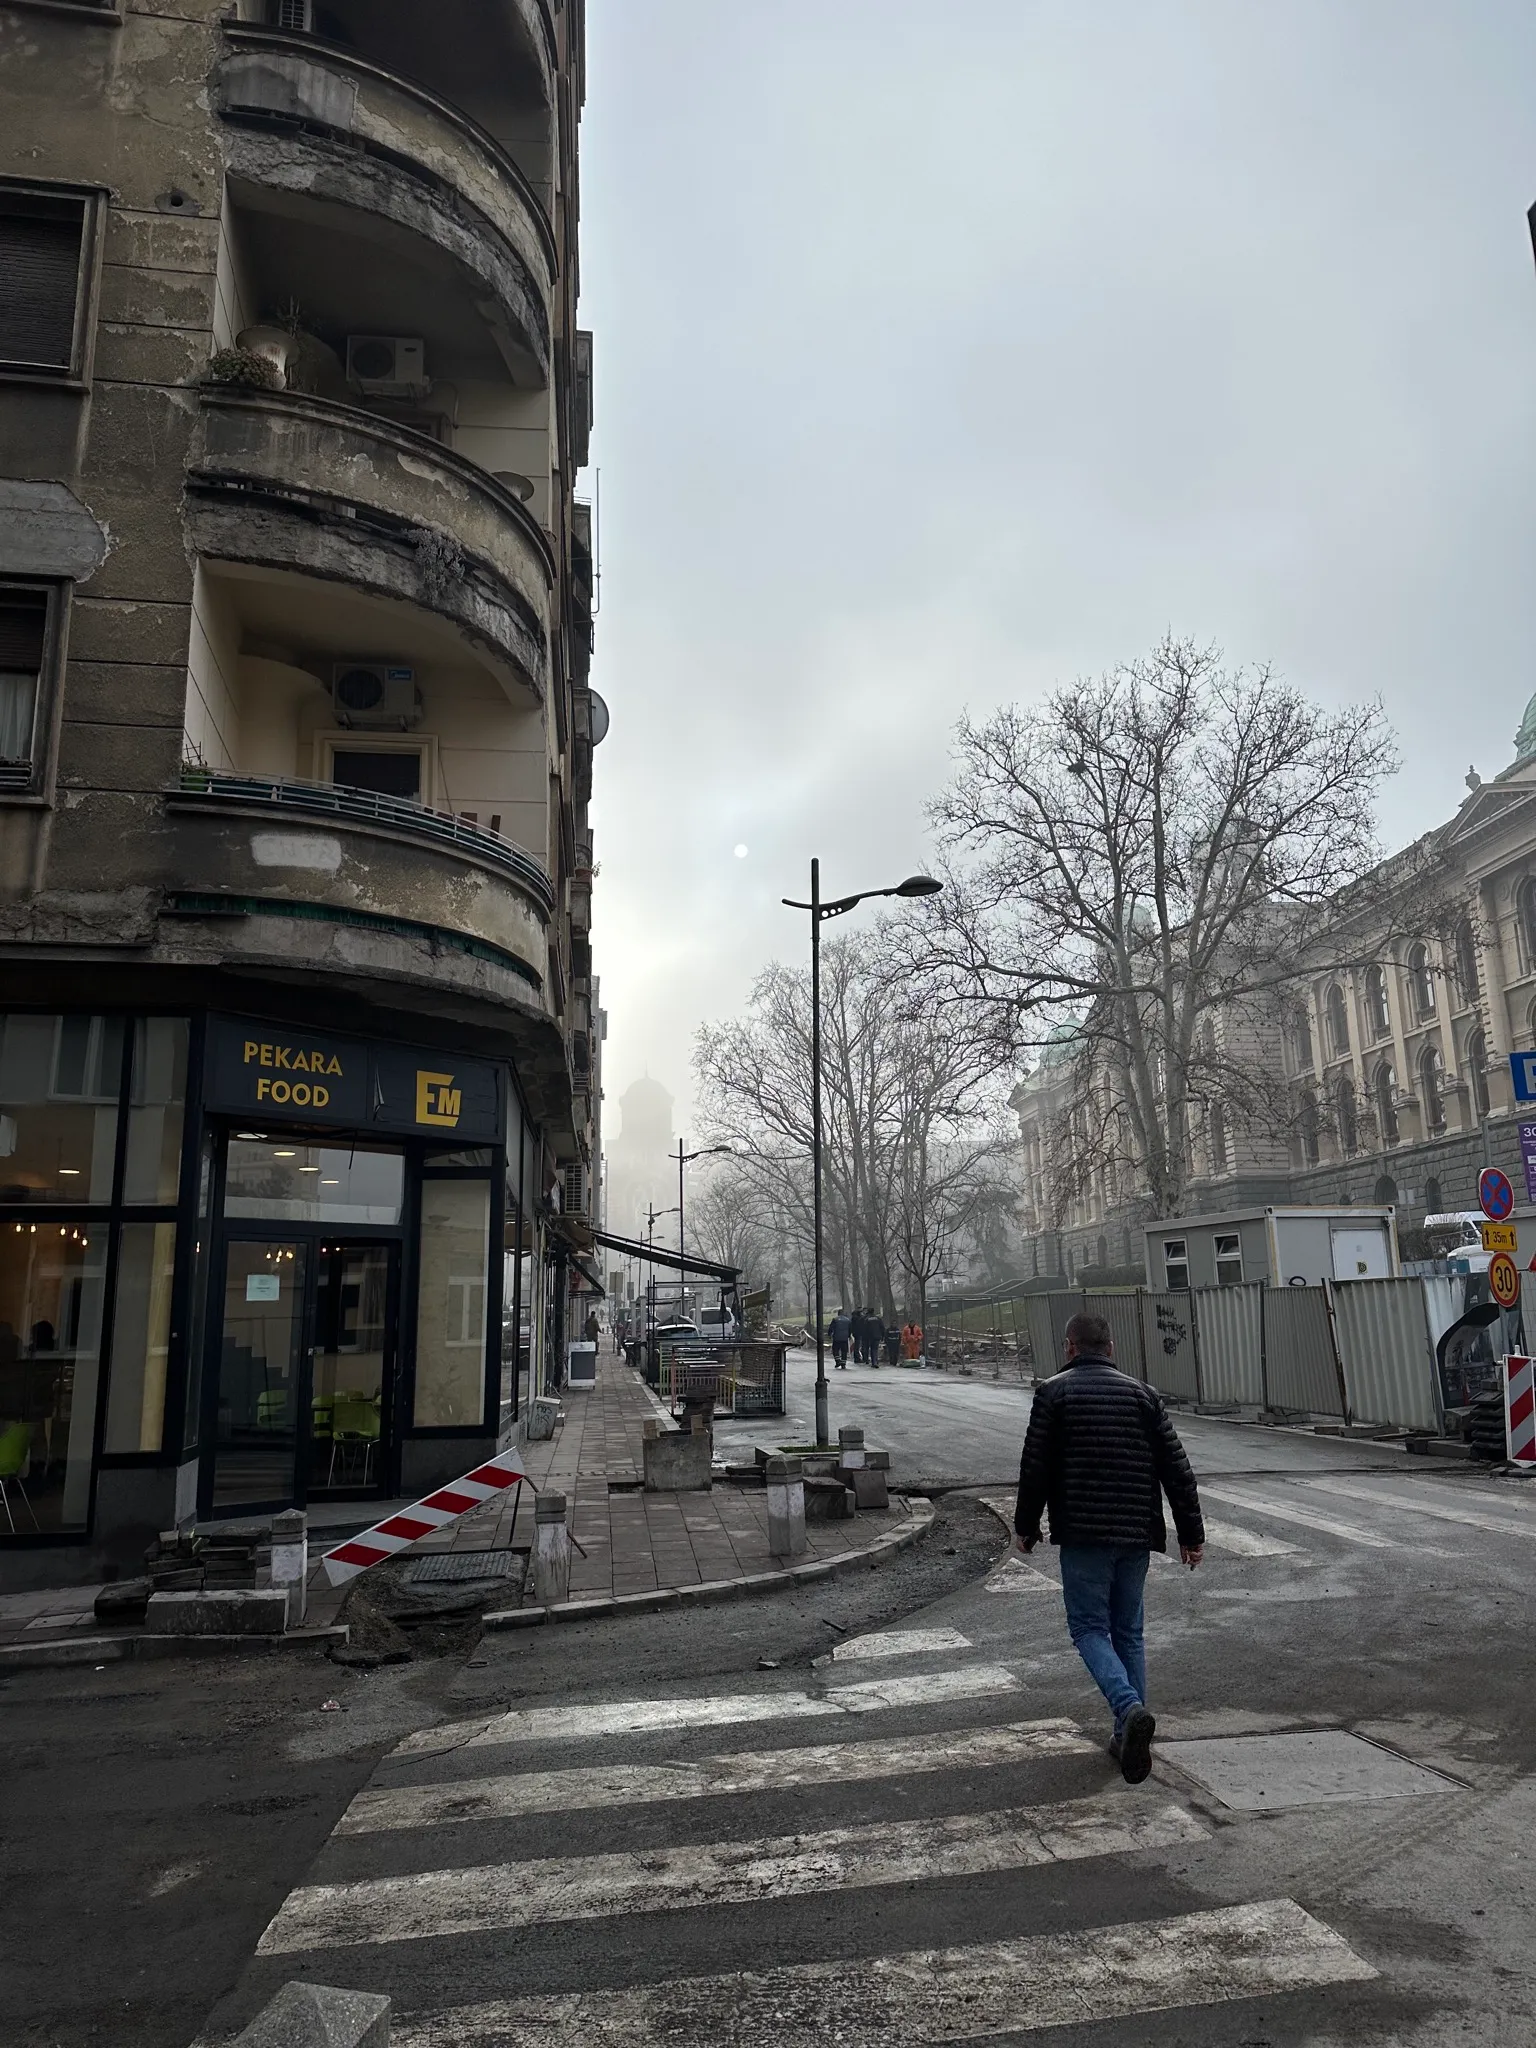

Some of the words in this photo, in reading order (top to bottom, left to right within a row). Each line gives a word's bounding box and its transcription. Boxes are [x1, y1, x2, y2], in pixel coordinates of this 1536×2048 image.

[243, 1041, 344, 1077] PEKARA
[256, 1078, 330, 1108] FOOD
[1492, 1231, 1508, 1244] 35m
[1495, 1265, 1513, 1293] 30
